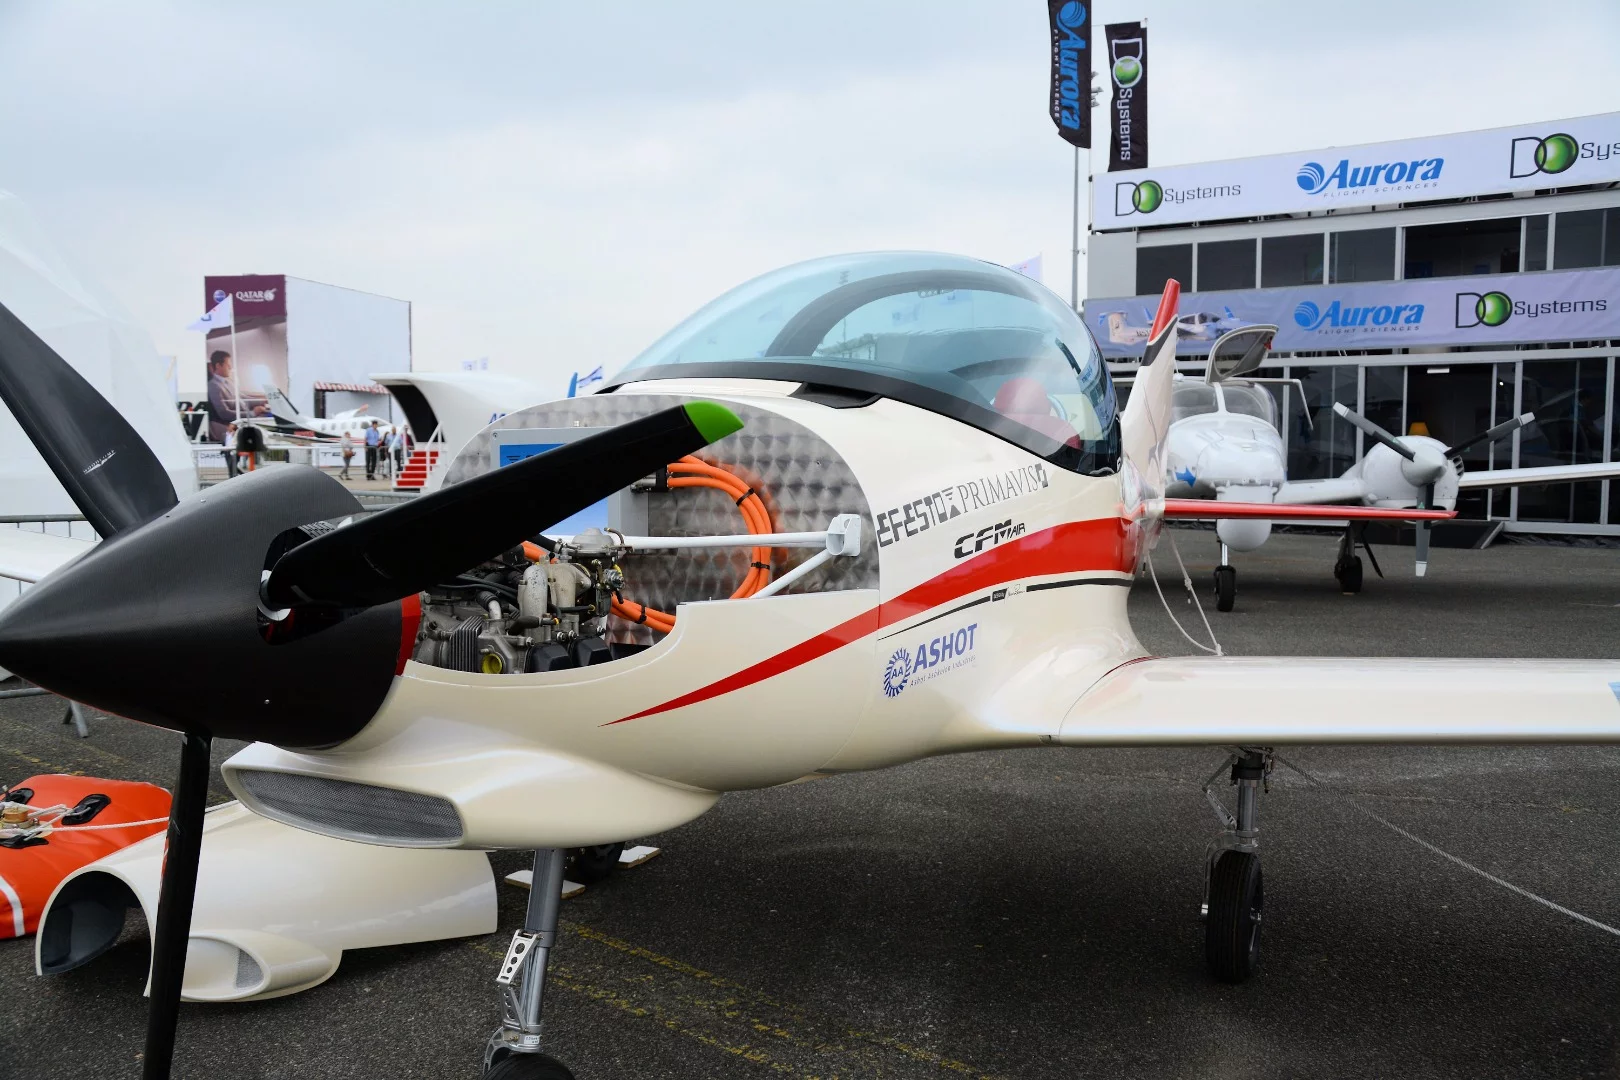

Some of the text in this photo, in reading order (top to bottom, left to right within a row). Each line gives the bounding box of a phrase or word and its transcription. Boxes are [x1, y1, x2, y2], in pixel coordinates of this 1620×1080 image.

[1059, 31, 1087, 130] Aurora
[1314, 157, 1445, 190] Aurora
[1323, 181, 1439, 199] FLIGHT SCIENCES
[235, 290, 264, 300] QATAR
[1315, 300, 1425, 328] Aurora
[1318, 325, 1420, 336] FLIGHT SCIENCES
[912, 622, 978, 674] ASHOT
[890, 666, 904, 680] AA
